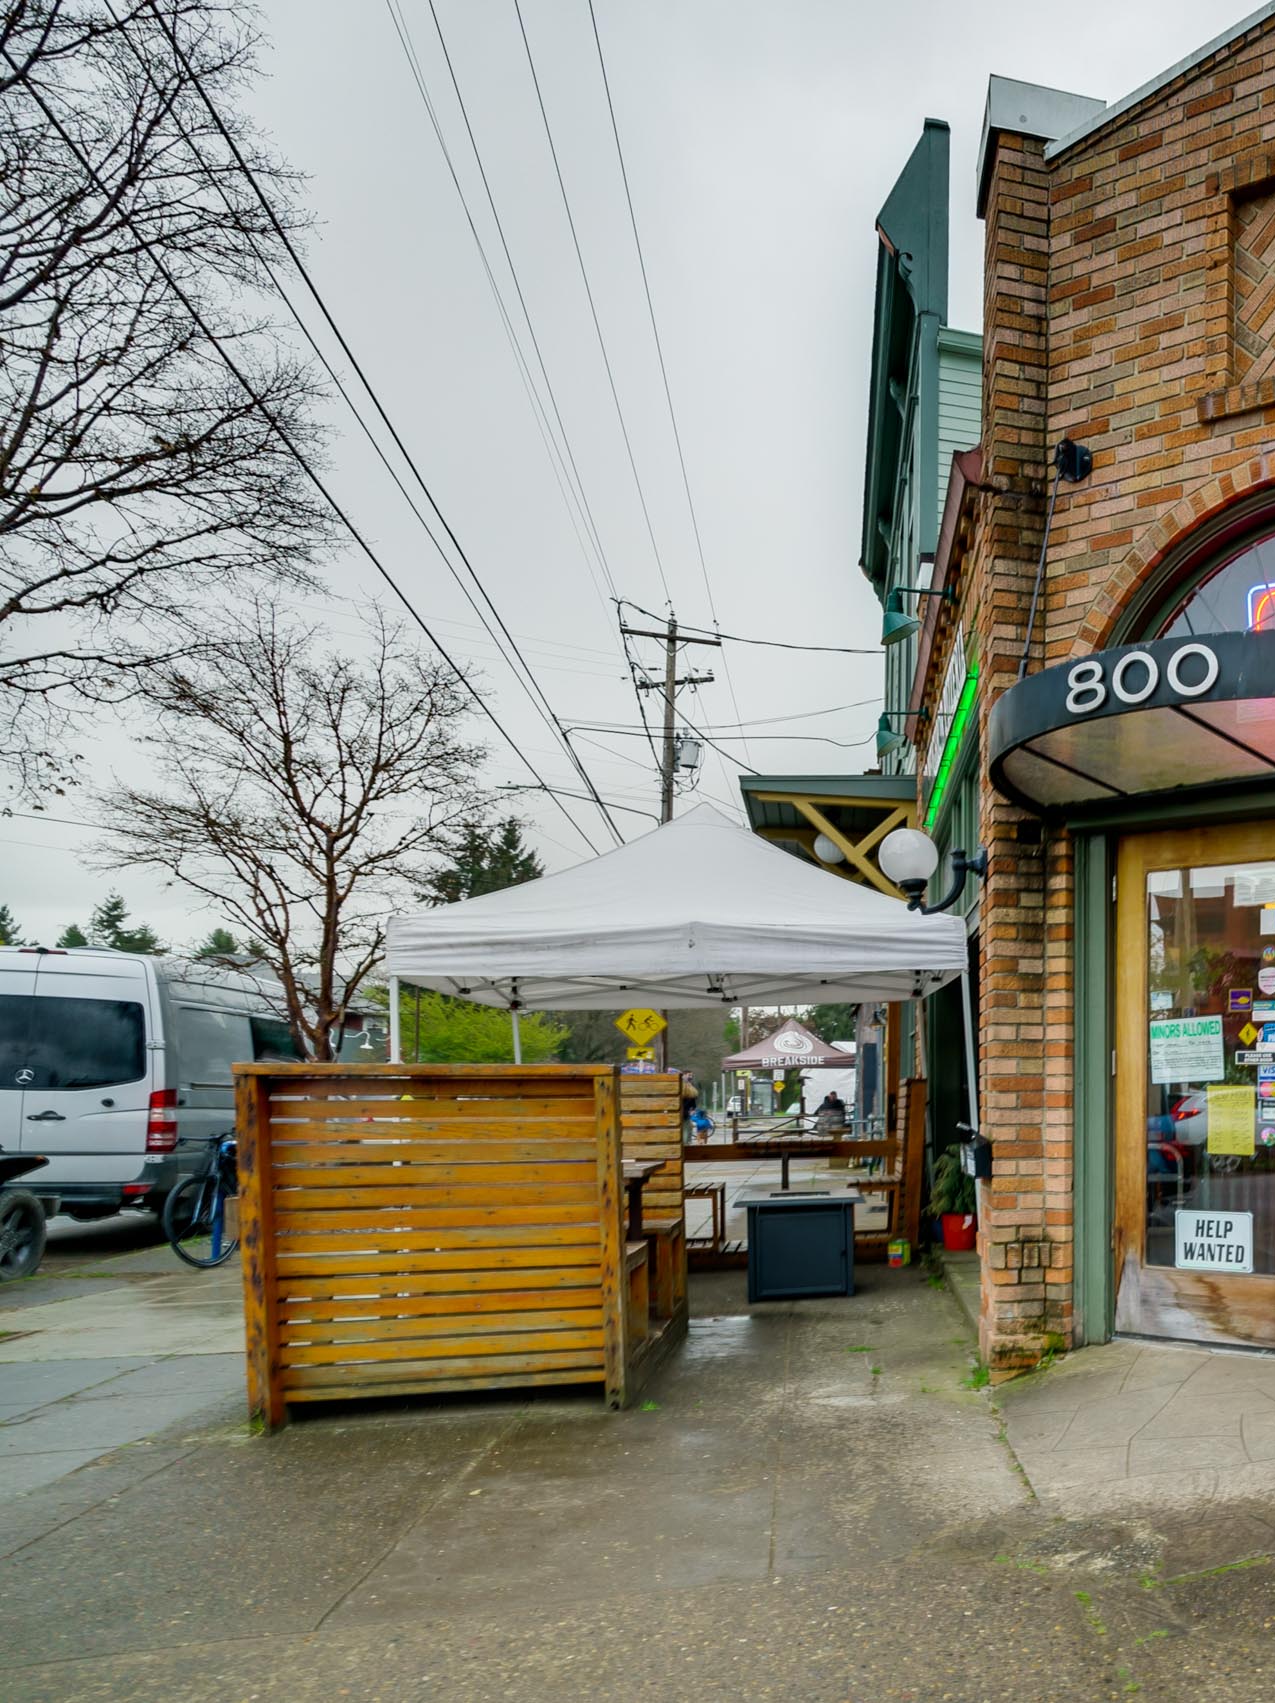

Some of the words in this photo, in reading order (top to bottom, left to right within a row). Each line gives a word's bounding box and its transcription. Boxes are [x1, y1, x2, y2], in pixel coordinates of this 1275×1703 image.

[1065, 643, 1219, 714] 800
[1151, 1023, 1181, 1040] MINORS
[1182, 1020, 1220, 1037] ALLOWED
[761, 1056, 825, 1067] BREAKSIDE
[1195, 1219, 1233, 1239] HELP
[1184, 1242, 1245, 1263] WANTED
